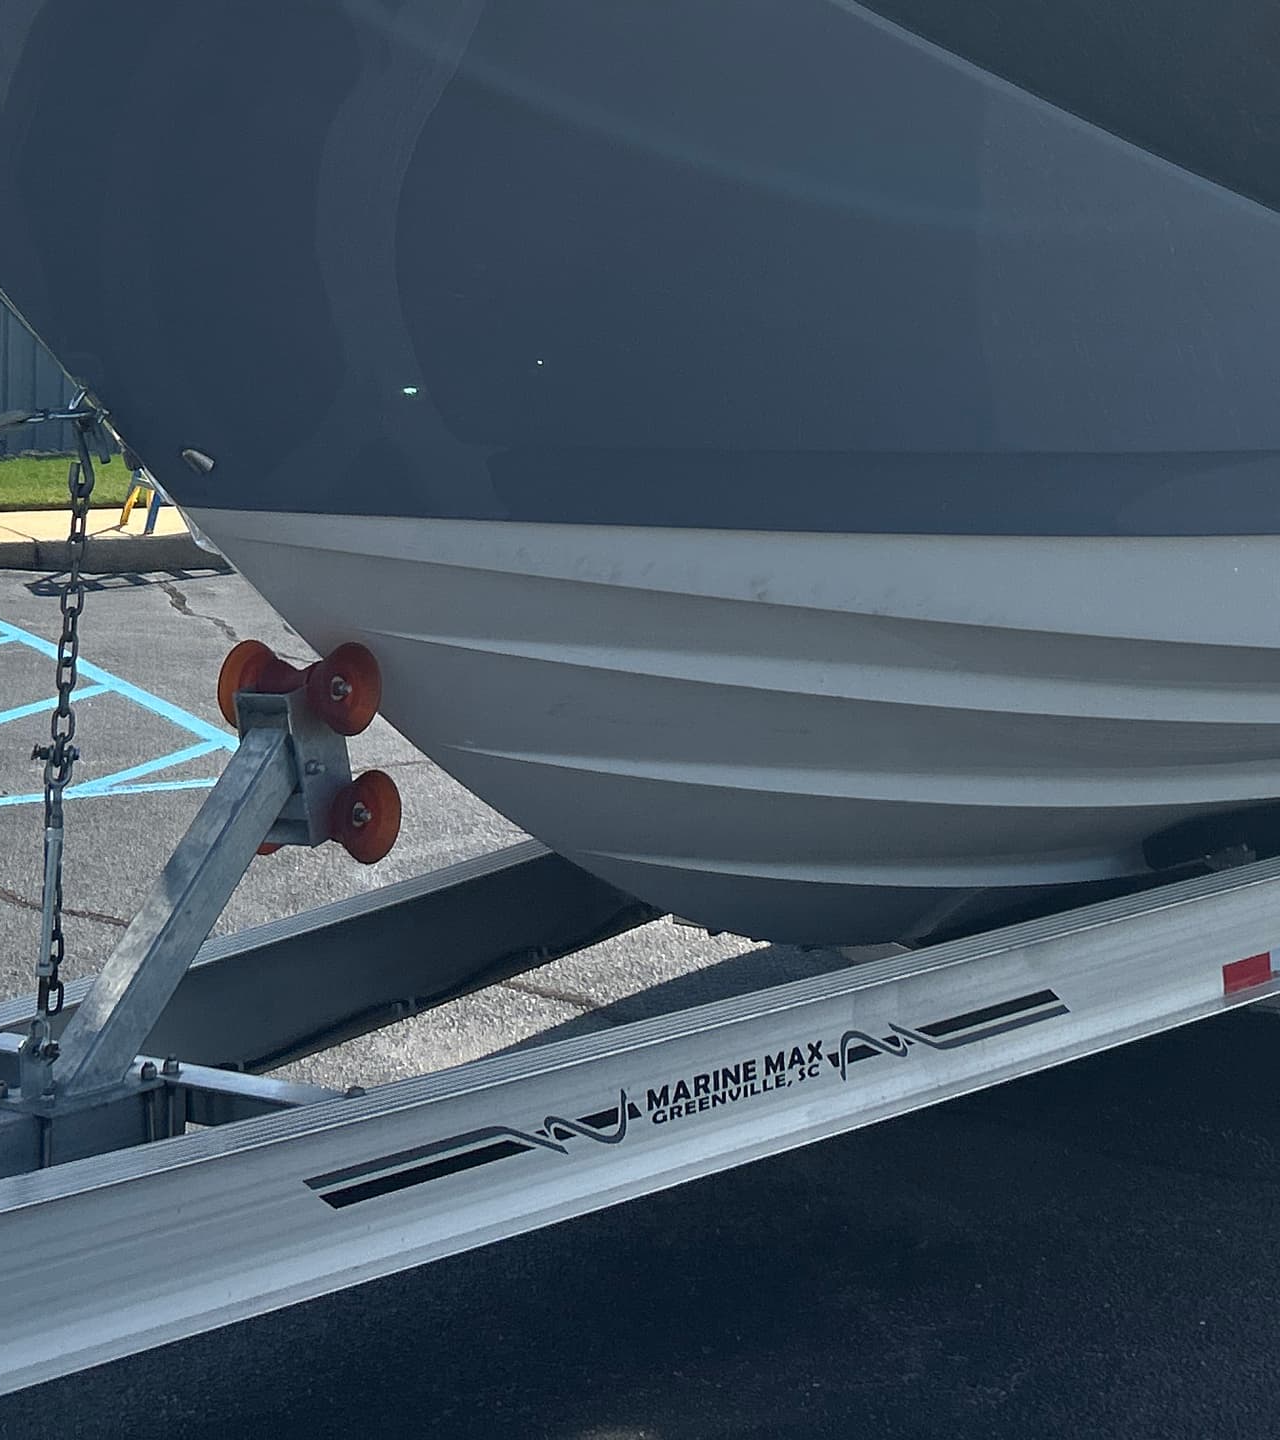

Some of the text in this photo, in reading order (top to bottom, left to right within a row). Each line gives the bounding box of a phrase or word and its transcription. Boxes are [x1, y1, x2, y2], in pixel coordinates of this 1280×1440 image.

[647, 1040, 823, 1112] MARINE MAX
[652, 1064, 821, 1125] GREENVILLE, SC
